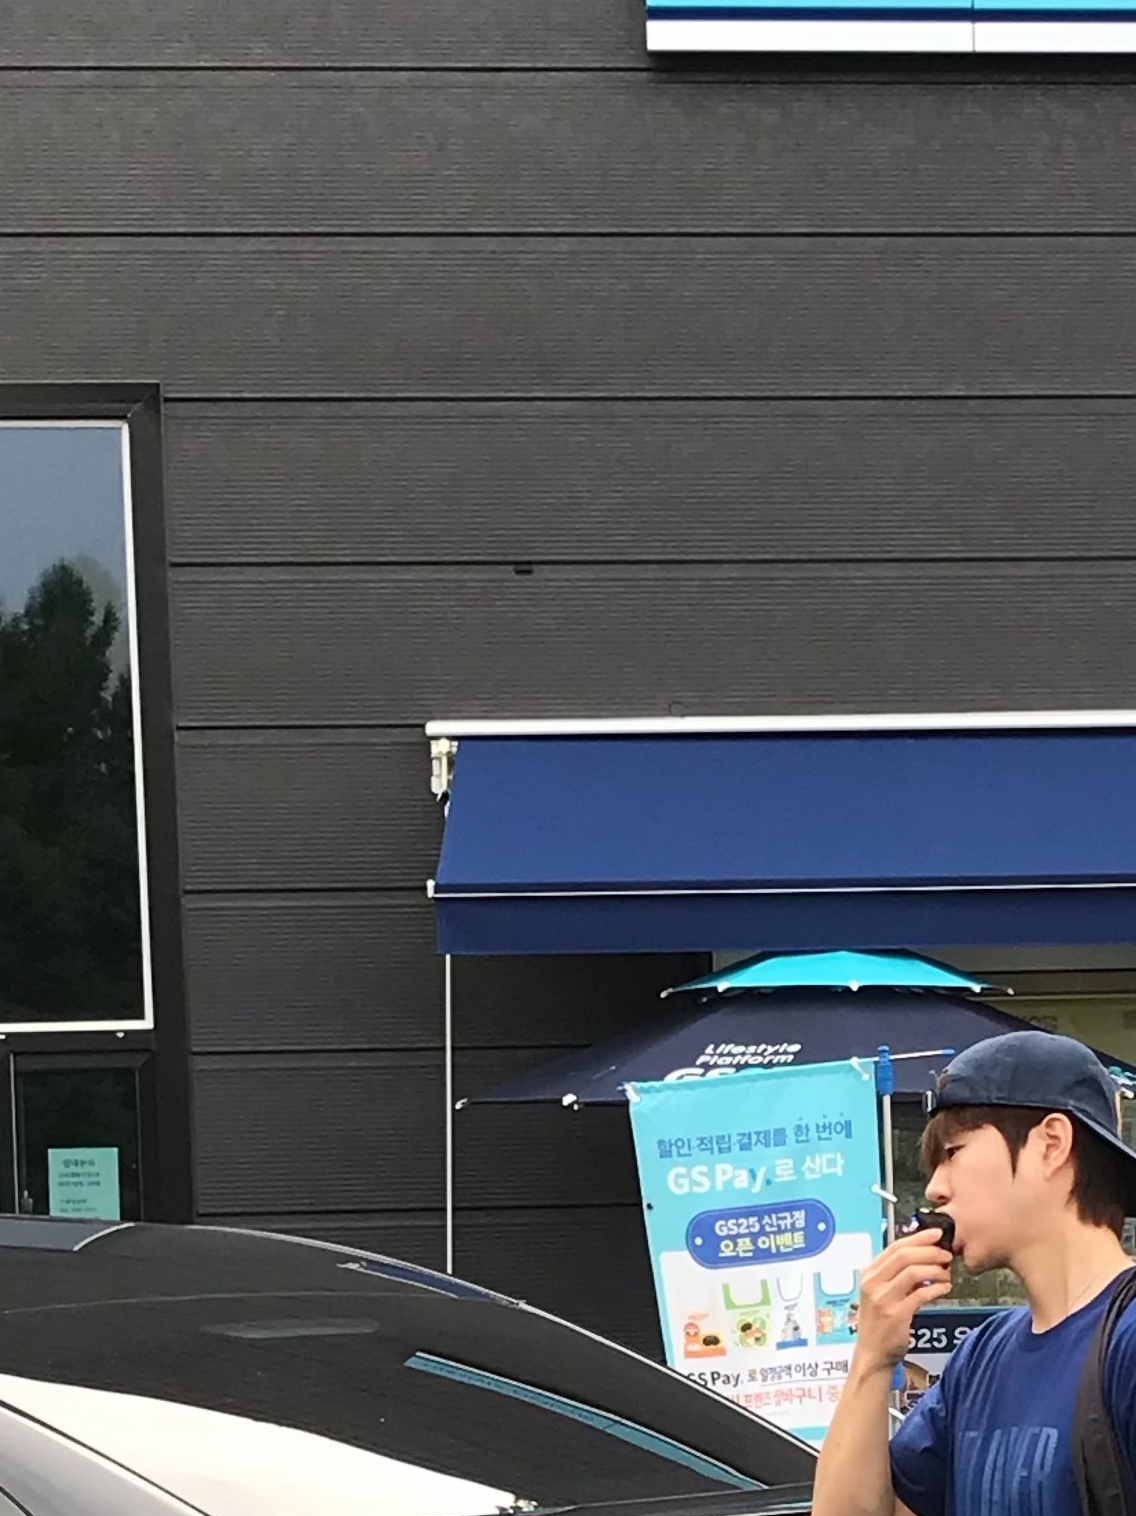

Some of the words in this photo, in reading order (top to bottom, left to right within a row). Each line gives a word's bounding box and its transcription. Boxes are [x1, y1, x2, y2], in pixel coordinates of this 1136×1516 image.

[695, 1053, 794, 1066] Platform
[704, 1042, 801, 1055] Lifestyle
[793, 1123, 811, 1144] 한
[815, 1119, 853, 1141] 번에
[774, 1158, 797, 1183] 로
[801, 1152, 845, 1180] 산다
[714, 1216, 760, 1236] GS25
[762, 1210, 806, 1232] 신규점
[718, 1238, 754, 1257] 오픈
[757, 1231, 805, 1254] 이벤트
[907, 1327, 948, 1349] S25
[747, 1368, 759, 1383] 로
[794, 1361, 819, 1377] 이상
[821, 1360, 849, 1376] 구매
